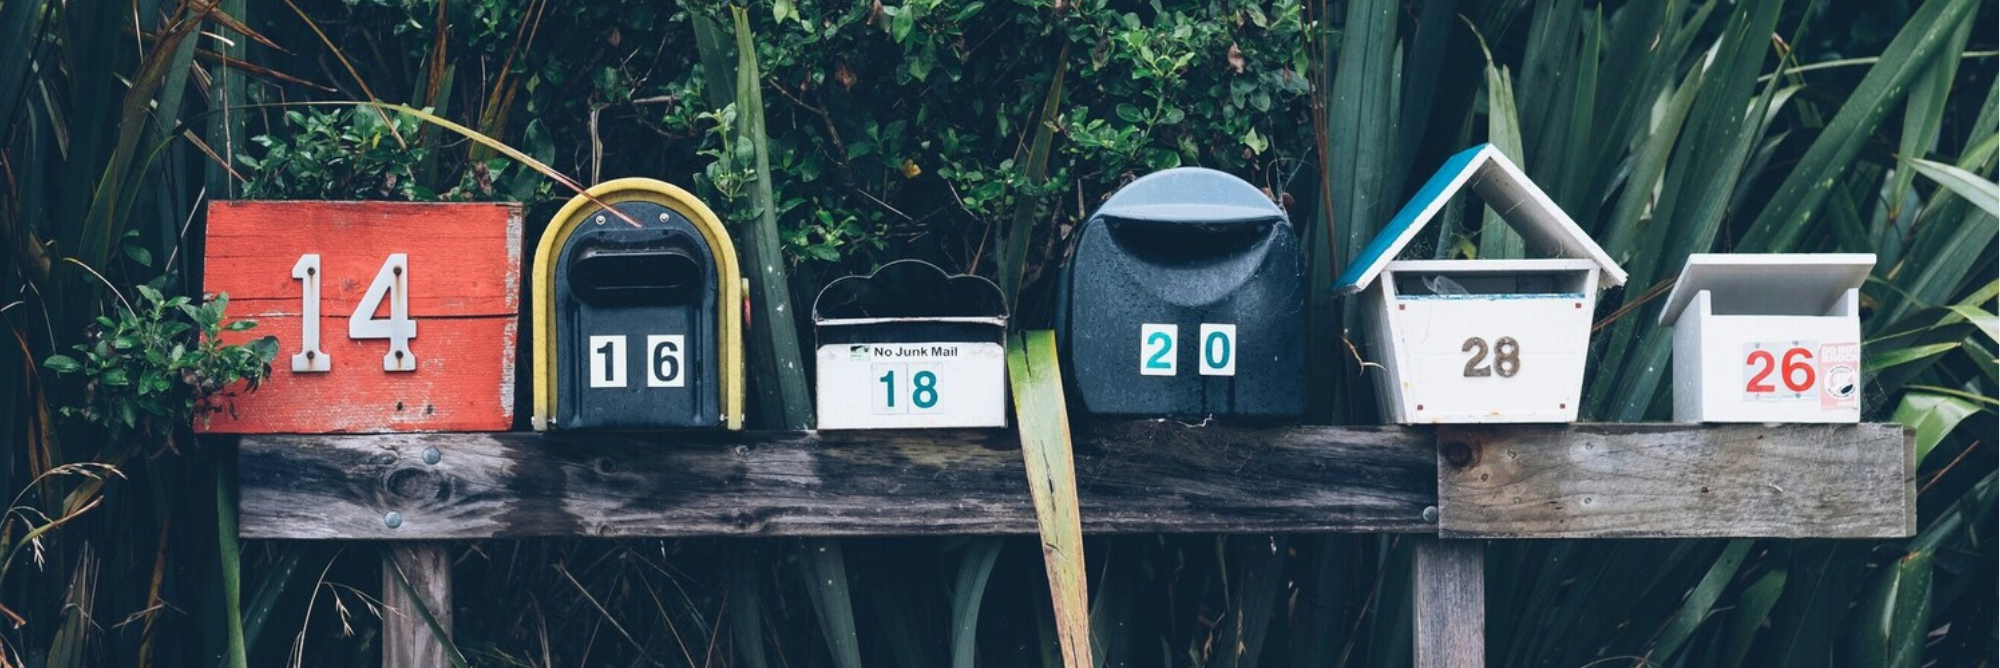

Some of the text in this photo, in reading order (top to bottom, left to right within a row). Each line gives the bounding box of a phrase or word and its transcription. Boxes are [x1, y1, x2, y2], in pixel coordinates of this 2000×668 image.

[291, 252, 418, 373] 14
[597, 341, 680, 382] 16
[874, 346, 959, 358] No Junk Mail
[1146, 331, 1231, 370] 20
[1461, 336, 1521, 378] 28
[1746, 347, 1816, 393] 26
[880, 369, 939, 408] 18
